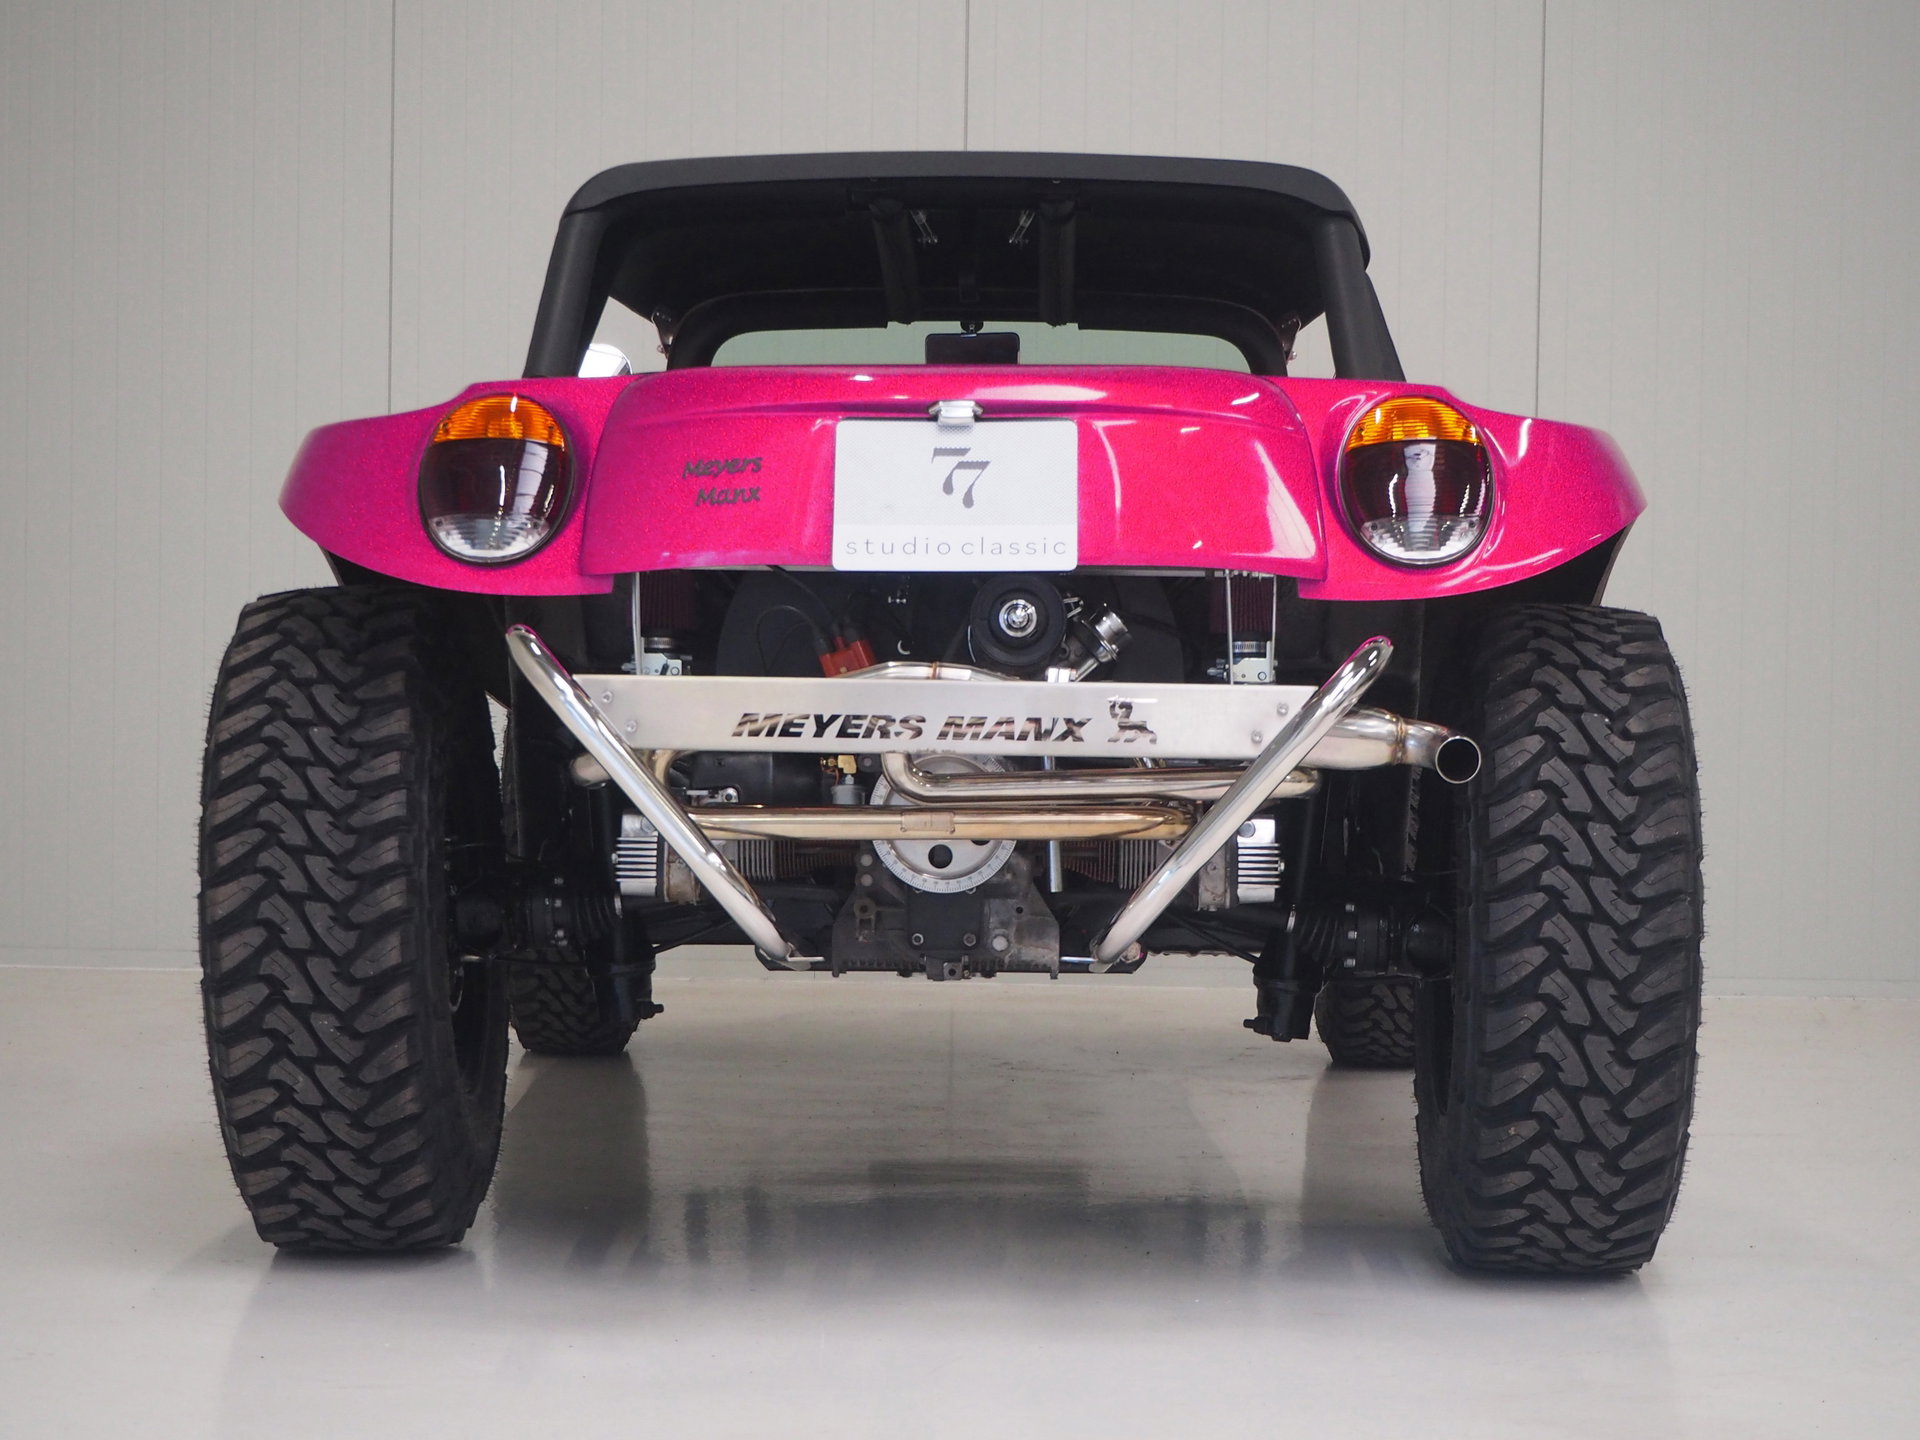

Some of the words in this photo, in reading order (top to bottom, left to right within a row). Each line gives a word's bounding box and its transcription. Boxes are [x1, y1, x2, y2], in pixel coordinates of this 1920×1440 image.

[682, 457, 763, 480] Meyers
[931, 446, 992, 509] 77
[695, 486, 761, 507] Manx
[845, 536, 951, 556] studio
[961, 536, 1067, 556] classic
[732, 712, 926, 740] MEYERS
[936, 715, 1092, 742] MANX
